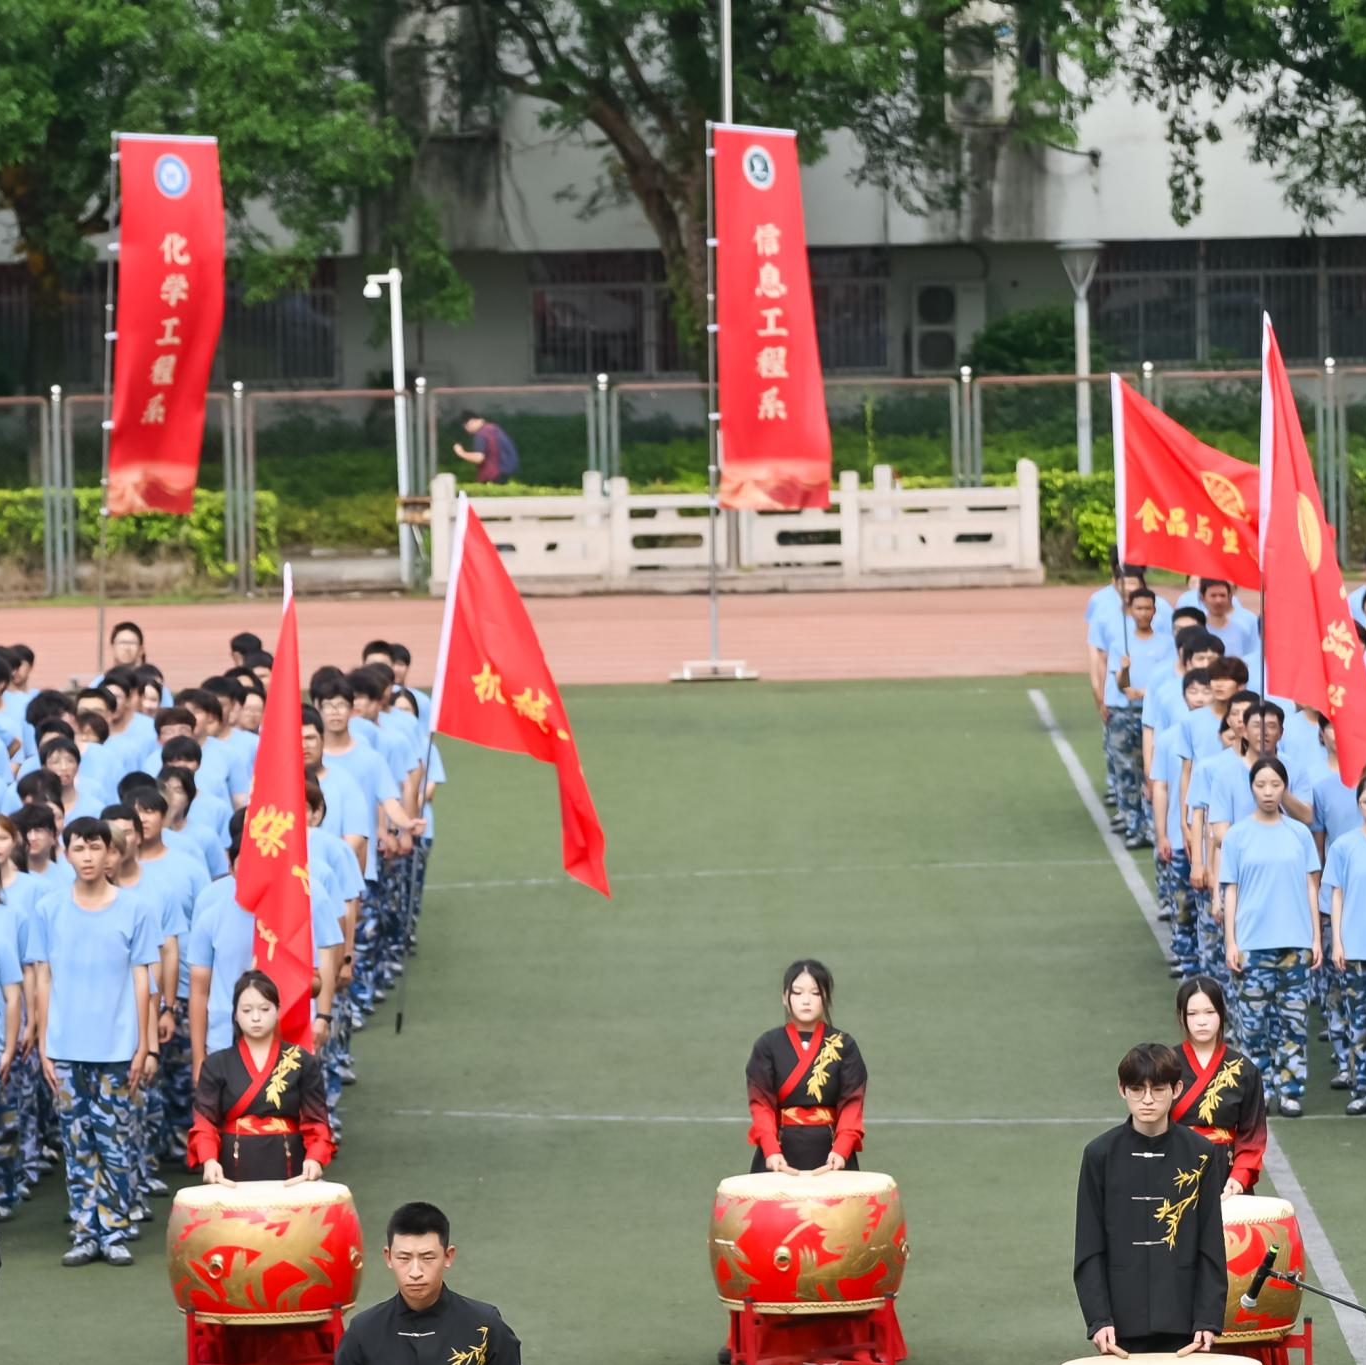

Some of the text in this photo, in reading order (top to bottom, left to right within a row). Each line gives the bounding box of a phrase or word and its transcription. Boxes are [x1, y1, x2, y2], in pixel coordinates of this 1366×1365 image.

[140, 232, 191, 425] 化学工程系
[753, 222, 788, 421] 信息工程系
[1134, 497, 1260, 563] 食品与生
[471, 662, 570, 741] 机械
